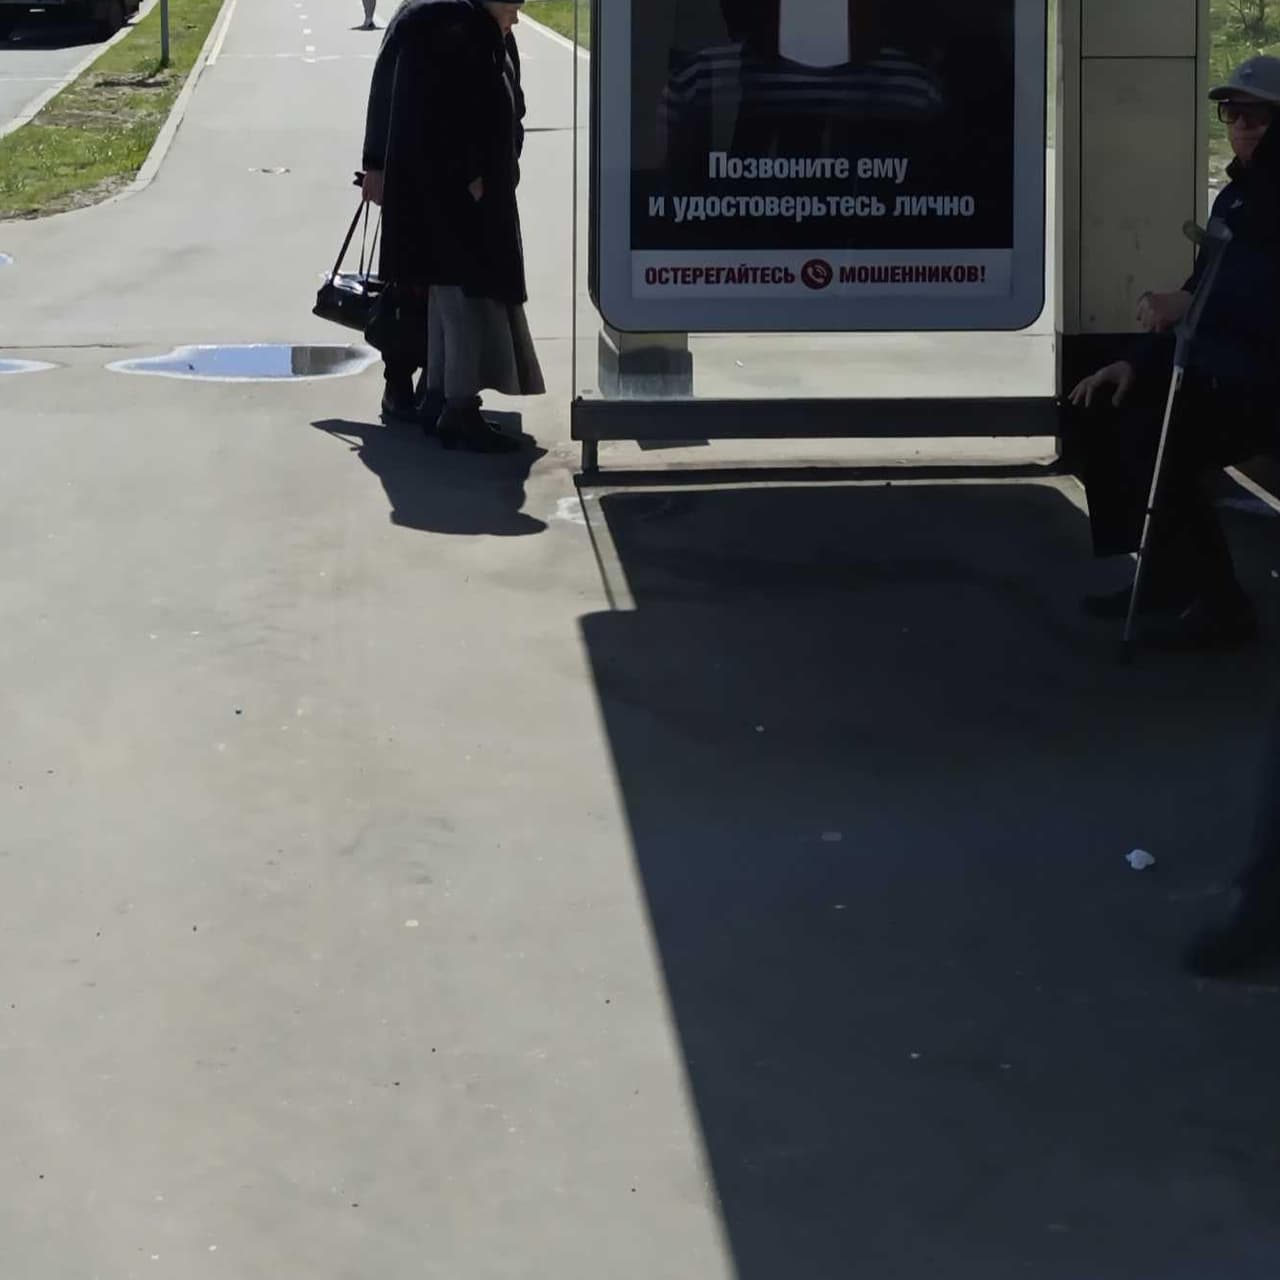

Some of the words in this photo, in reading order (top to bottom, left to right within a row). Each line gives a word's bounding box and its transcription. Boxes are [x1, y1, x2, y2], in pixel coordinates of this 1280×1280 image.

[709, 152, 849, 179] Позвоните
[857, 158, 908, 183] ему
[649, 196, 664, 217] и
[673, 196, 886, 222] удостоверьтесь
[893, 195, 976, 216] лично
[645, 263, 795, 285] ОСТЕРЕГАЙТЕСЬ
[839, 265, 986, 283] МОШЕННИКОВ!
